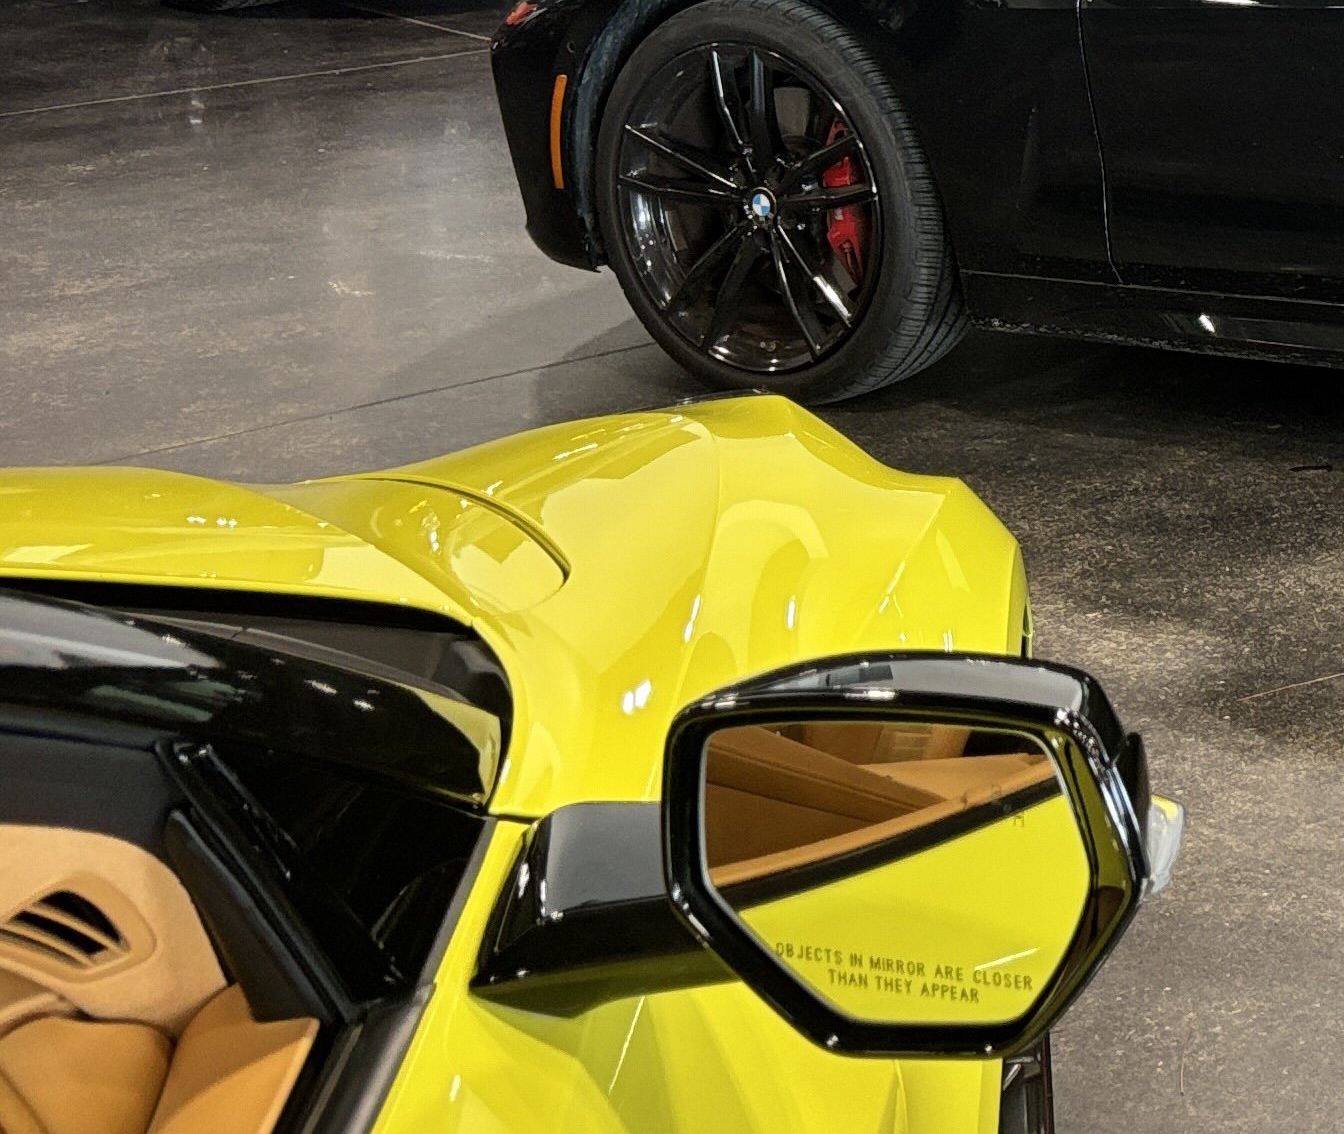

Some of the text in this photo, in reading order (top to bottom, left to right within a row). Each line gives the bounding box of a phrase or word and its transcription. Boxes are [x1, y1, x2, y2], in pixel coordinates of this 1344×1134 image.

[775, 942, 1033, 990] OBJECTS IN MIRROR ARE CLOSER
[828, 968, 980, 1003] THAN THEY APPEAR
